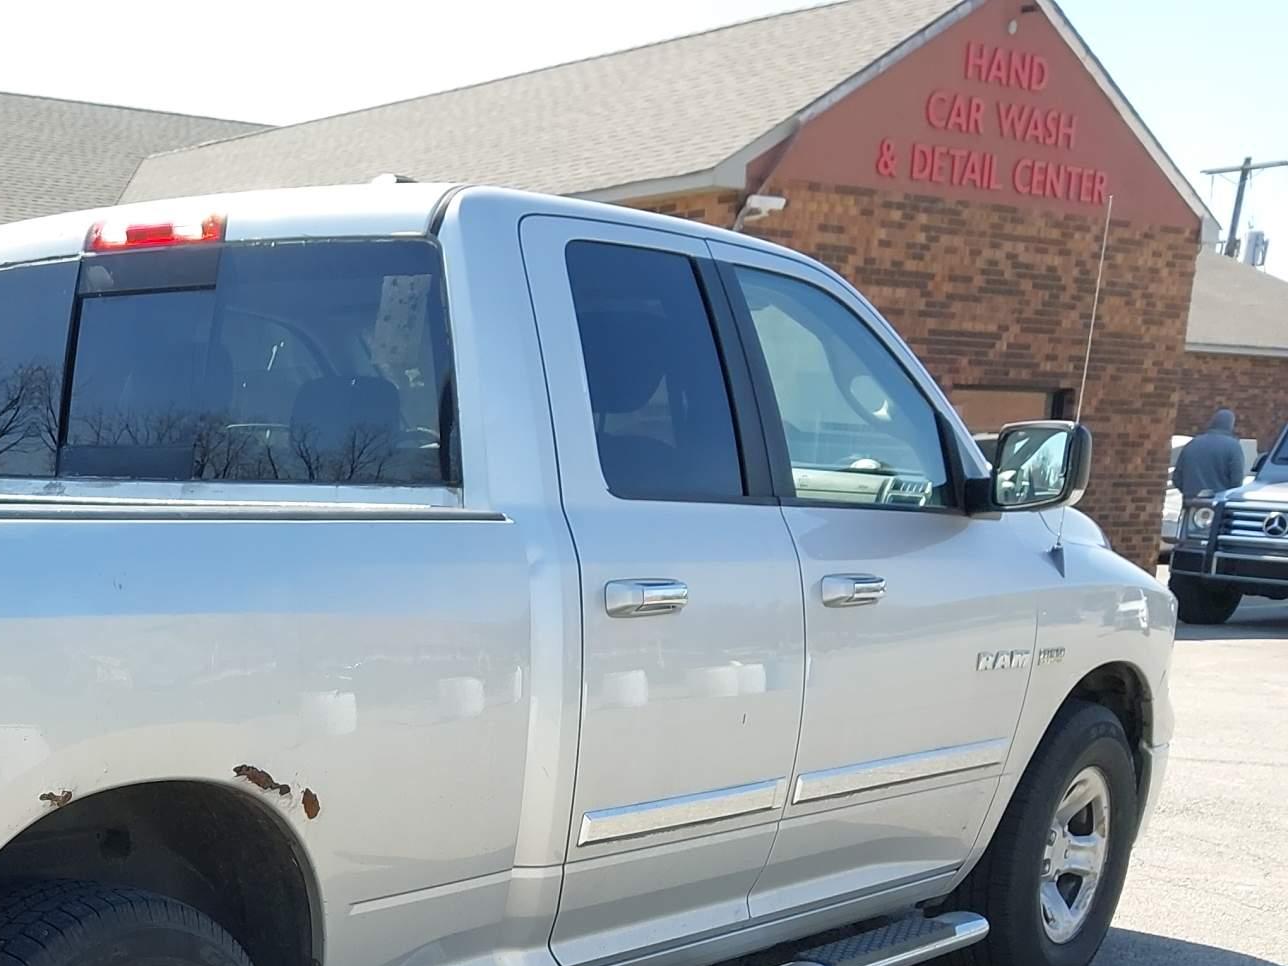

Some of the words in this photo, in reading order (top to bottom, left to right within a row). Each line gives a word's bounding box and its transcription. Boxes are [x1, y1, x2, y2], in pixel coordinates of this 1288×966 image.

[965, 42, 1048, 91] HAND
[926, 91, 984, 134] CAR
[997, 103, 1078, 149] WASH
[876, 137, 897, 178] &
[910, 143, 1002, 191] DETAIL
[1013, 158, 1108, 205] CENTER
[976, 650, 1031, 671] RAM
